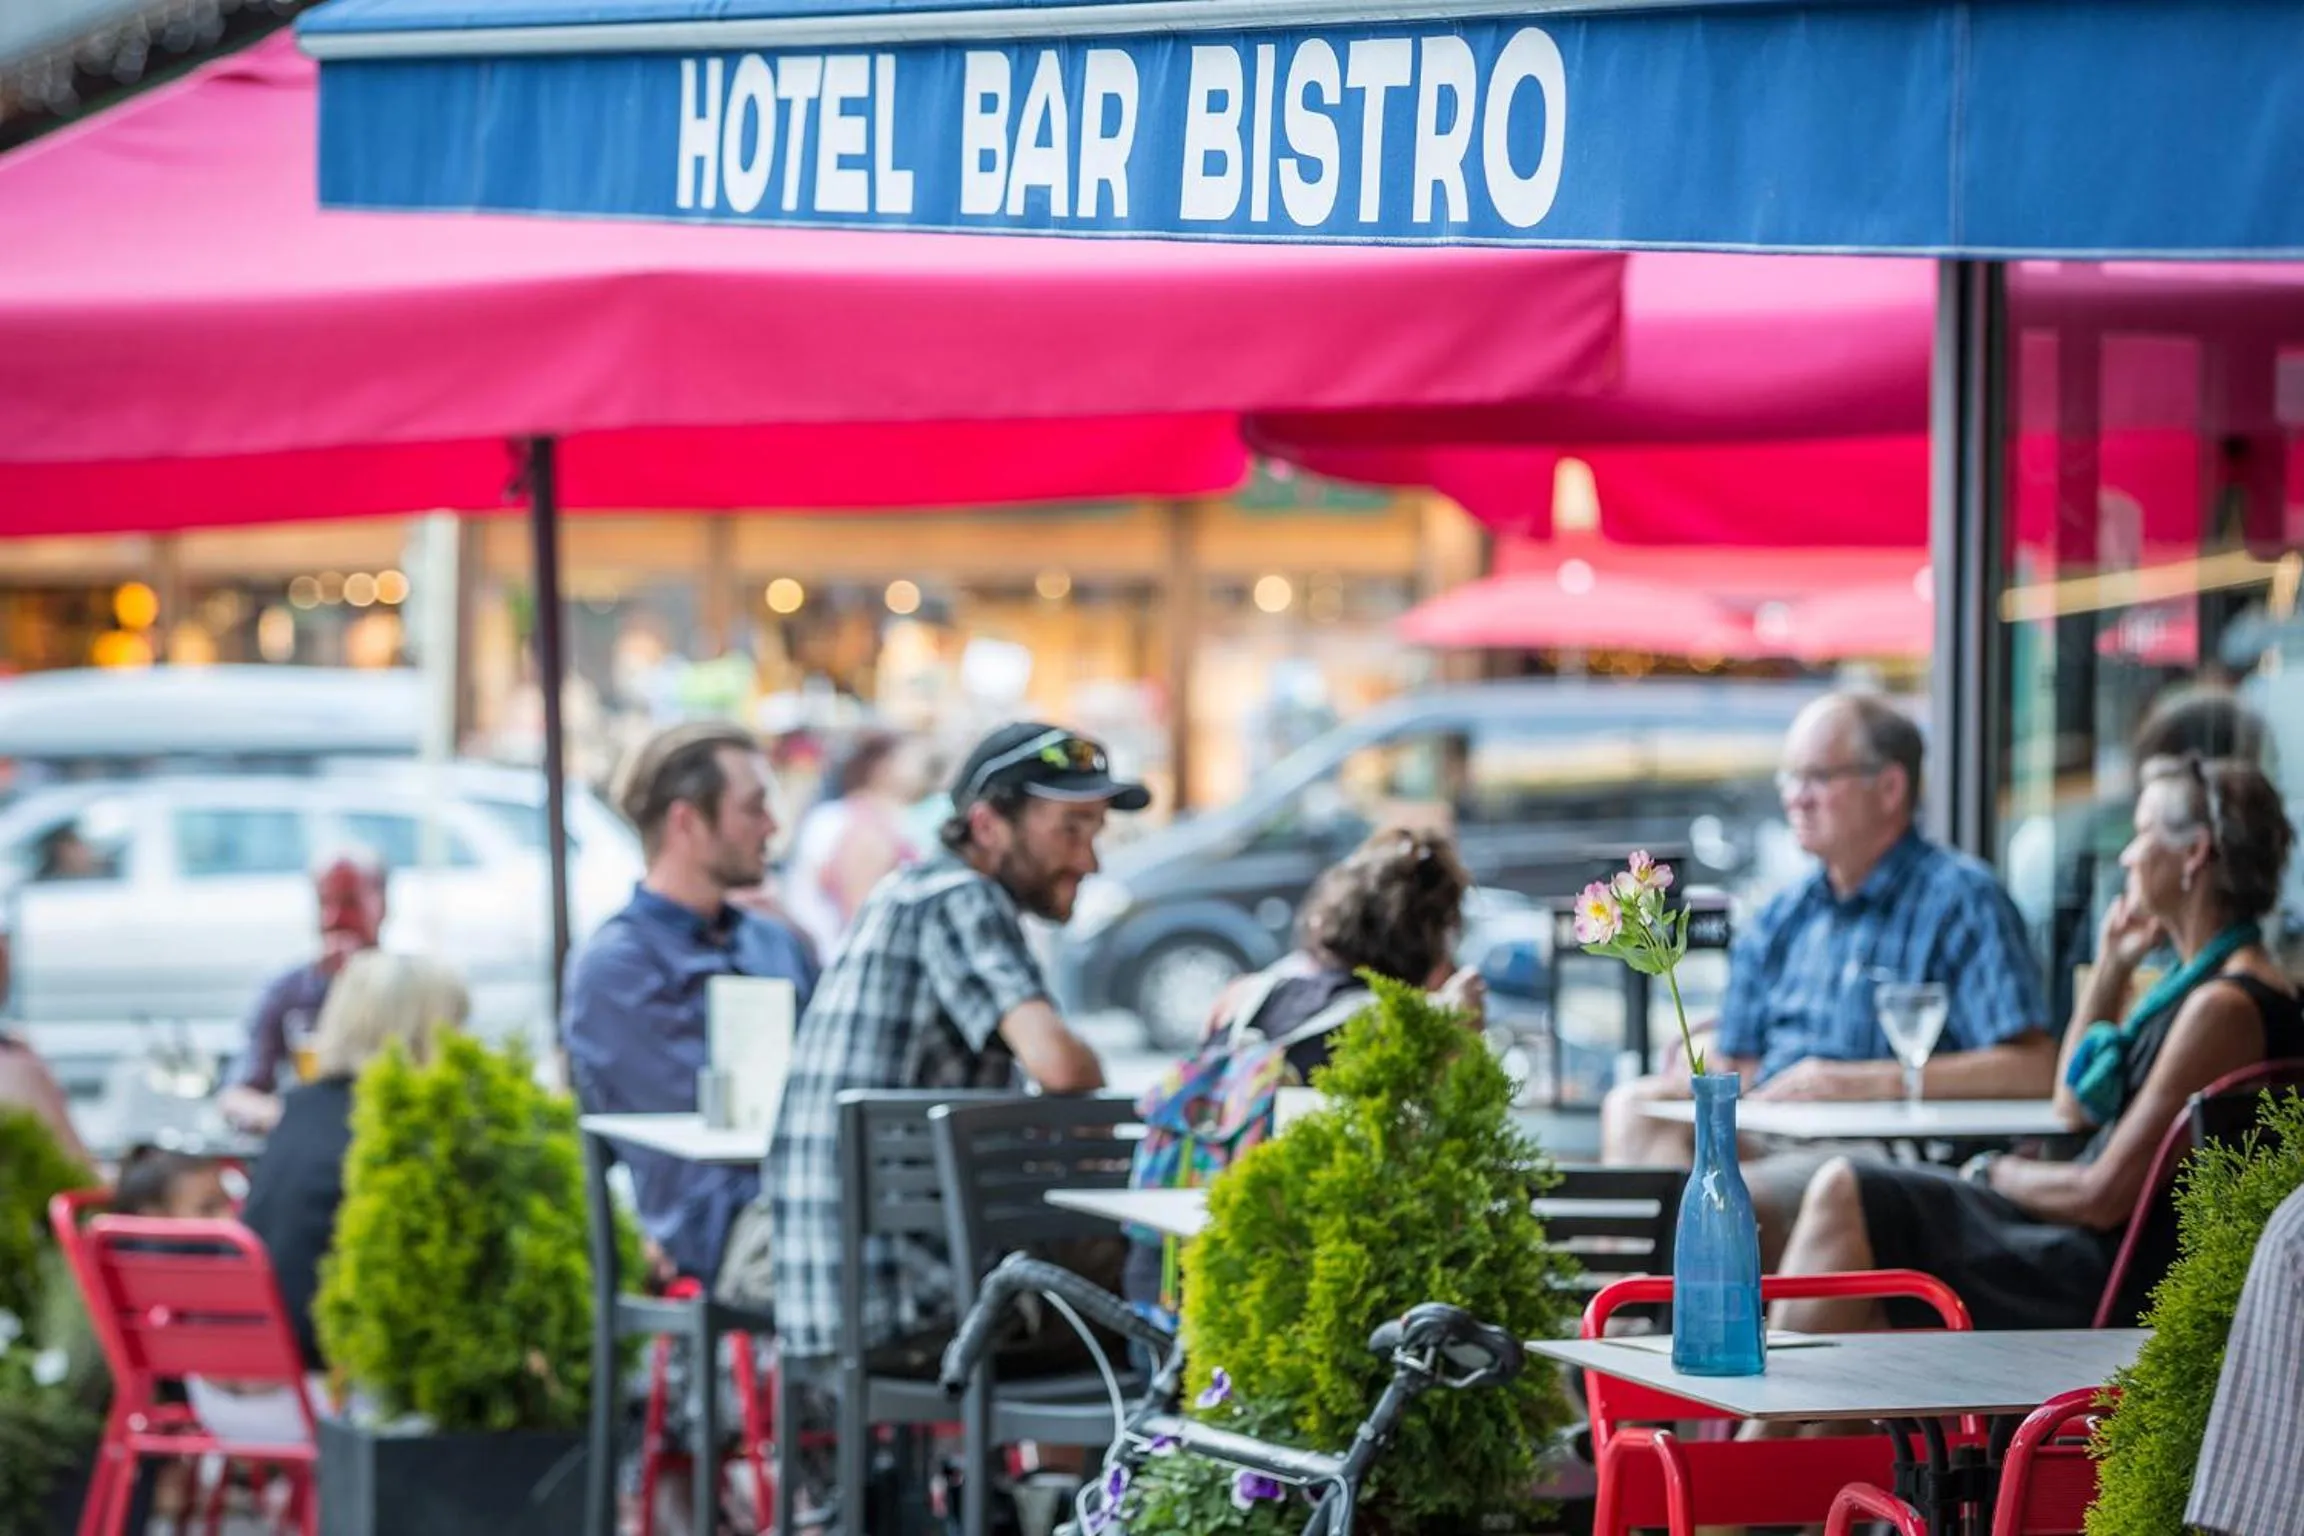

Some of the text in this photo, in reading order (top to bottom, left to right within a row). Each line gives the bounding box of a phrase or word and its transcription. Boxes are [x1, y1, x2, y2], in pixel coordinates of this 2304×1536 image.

[676, 26, 1567, 228] HOTEL BAR BISTRO
